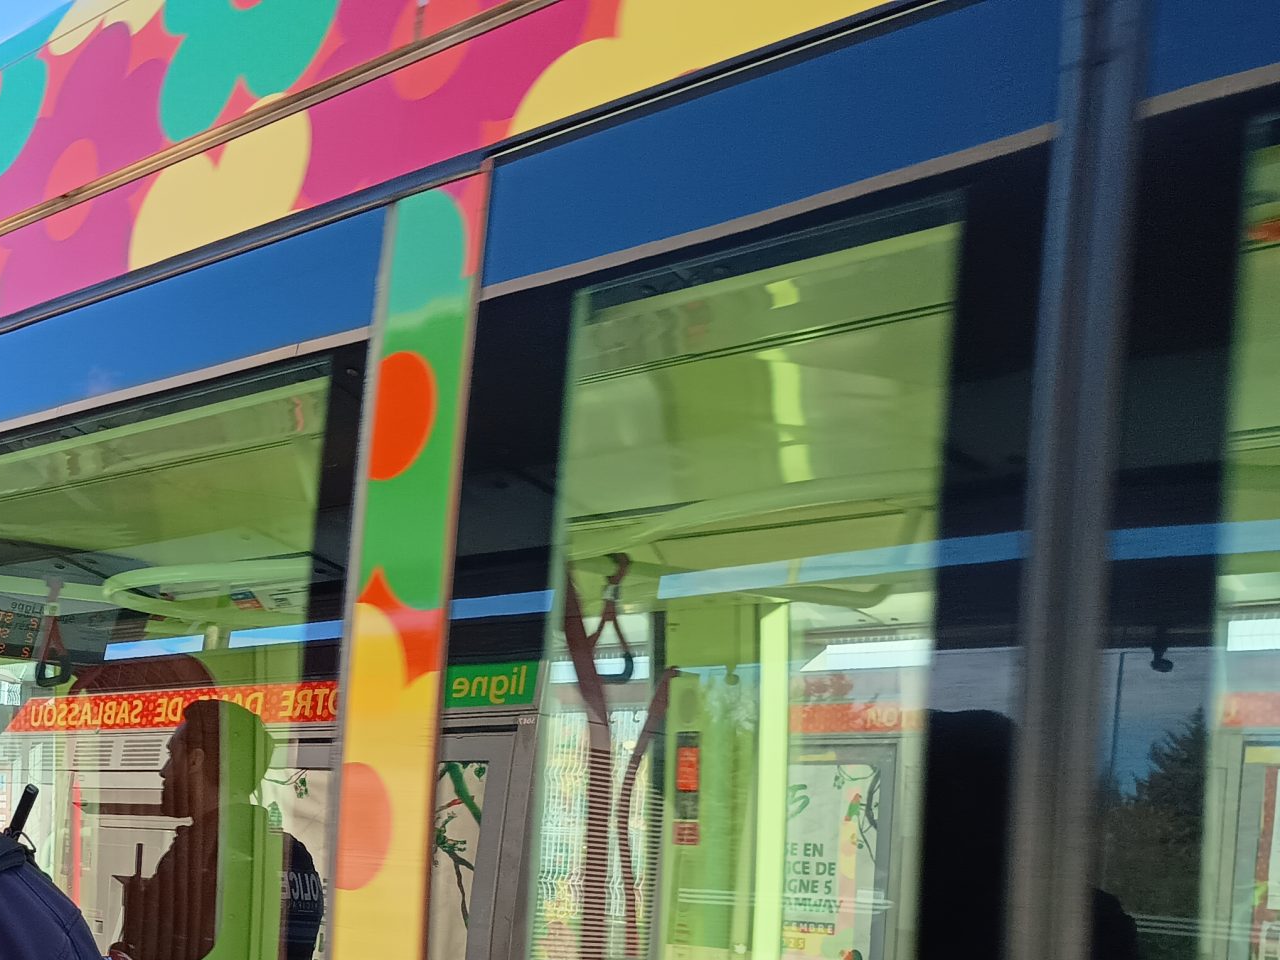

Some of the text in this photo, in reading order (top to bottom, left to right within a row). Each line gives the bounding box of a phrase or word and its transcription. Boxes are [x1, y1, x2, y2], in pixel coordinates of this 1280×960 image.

[803, 843, 823, 857] EN
[816, 862, 836, 876] DE
[824, 880, 832, 895] 5
